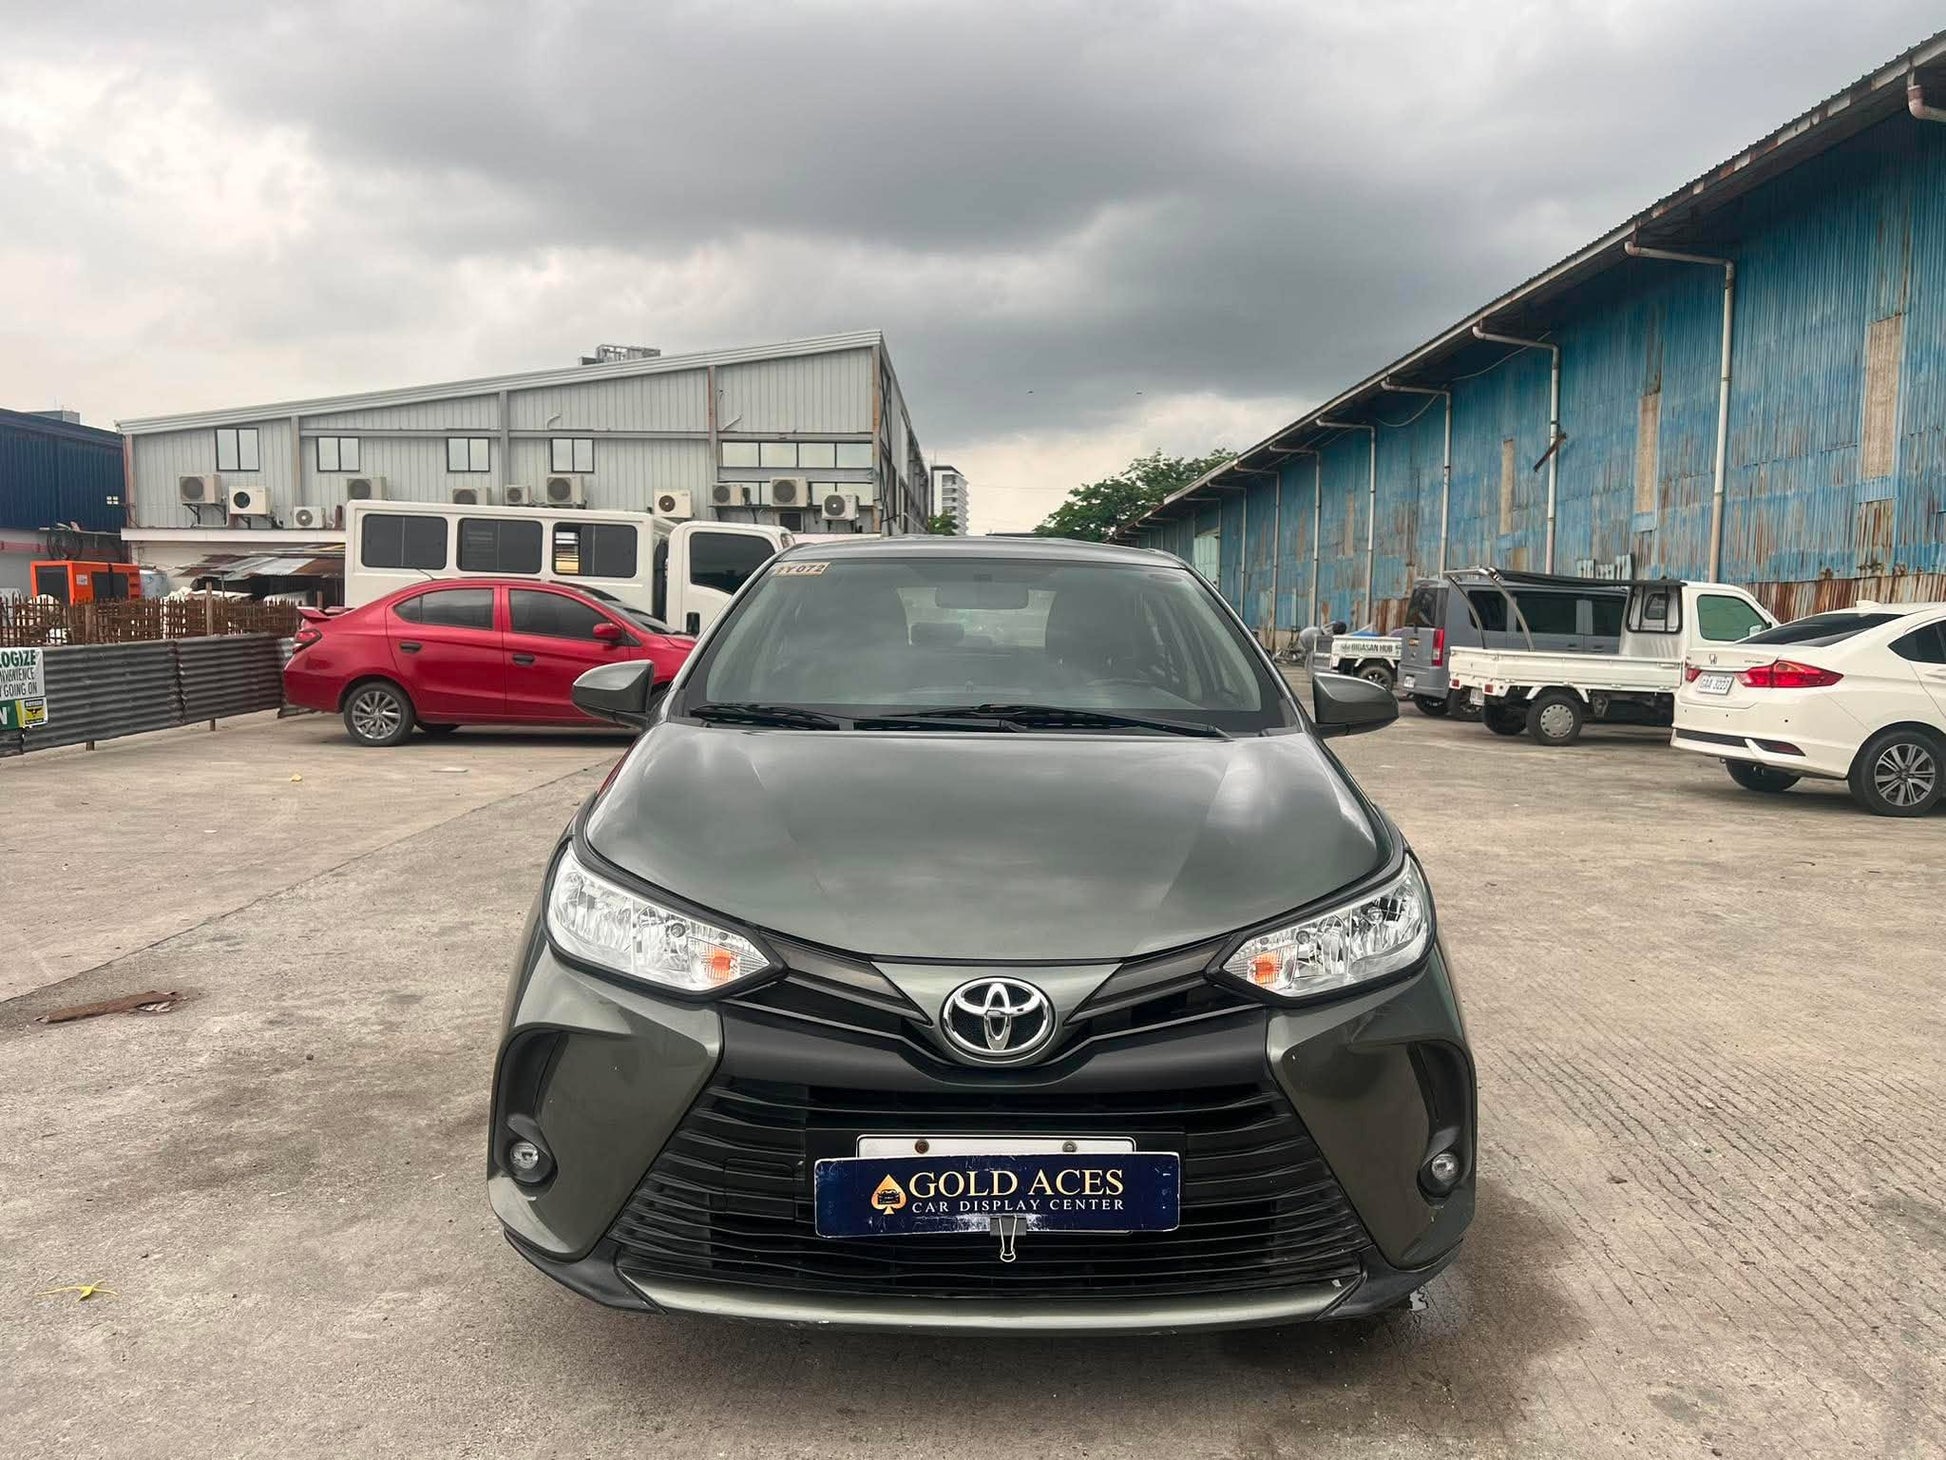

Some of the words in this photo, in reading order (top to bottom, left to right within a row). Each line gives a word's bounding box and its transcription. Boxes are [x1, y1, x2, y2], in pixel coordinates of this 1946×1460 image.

[0, 650, 36, 668] OGIZE
[3, 682, 26, 698] GOING
[28, 681, 38, 695] ON
[909, 1170, 1018, 1199] GOLD
[1027, 1168, 1124, 1195] ACES
[912, 1201, 949, 1213] CAR
[960, 1199, 1040, 1212] DISPLAY
[1049, 1199, 1124, 1210] CENTER
